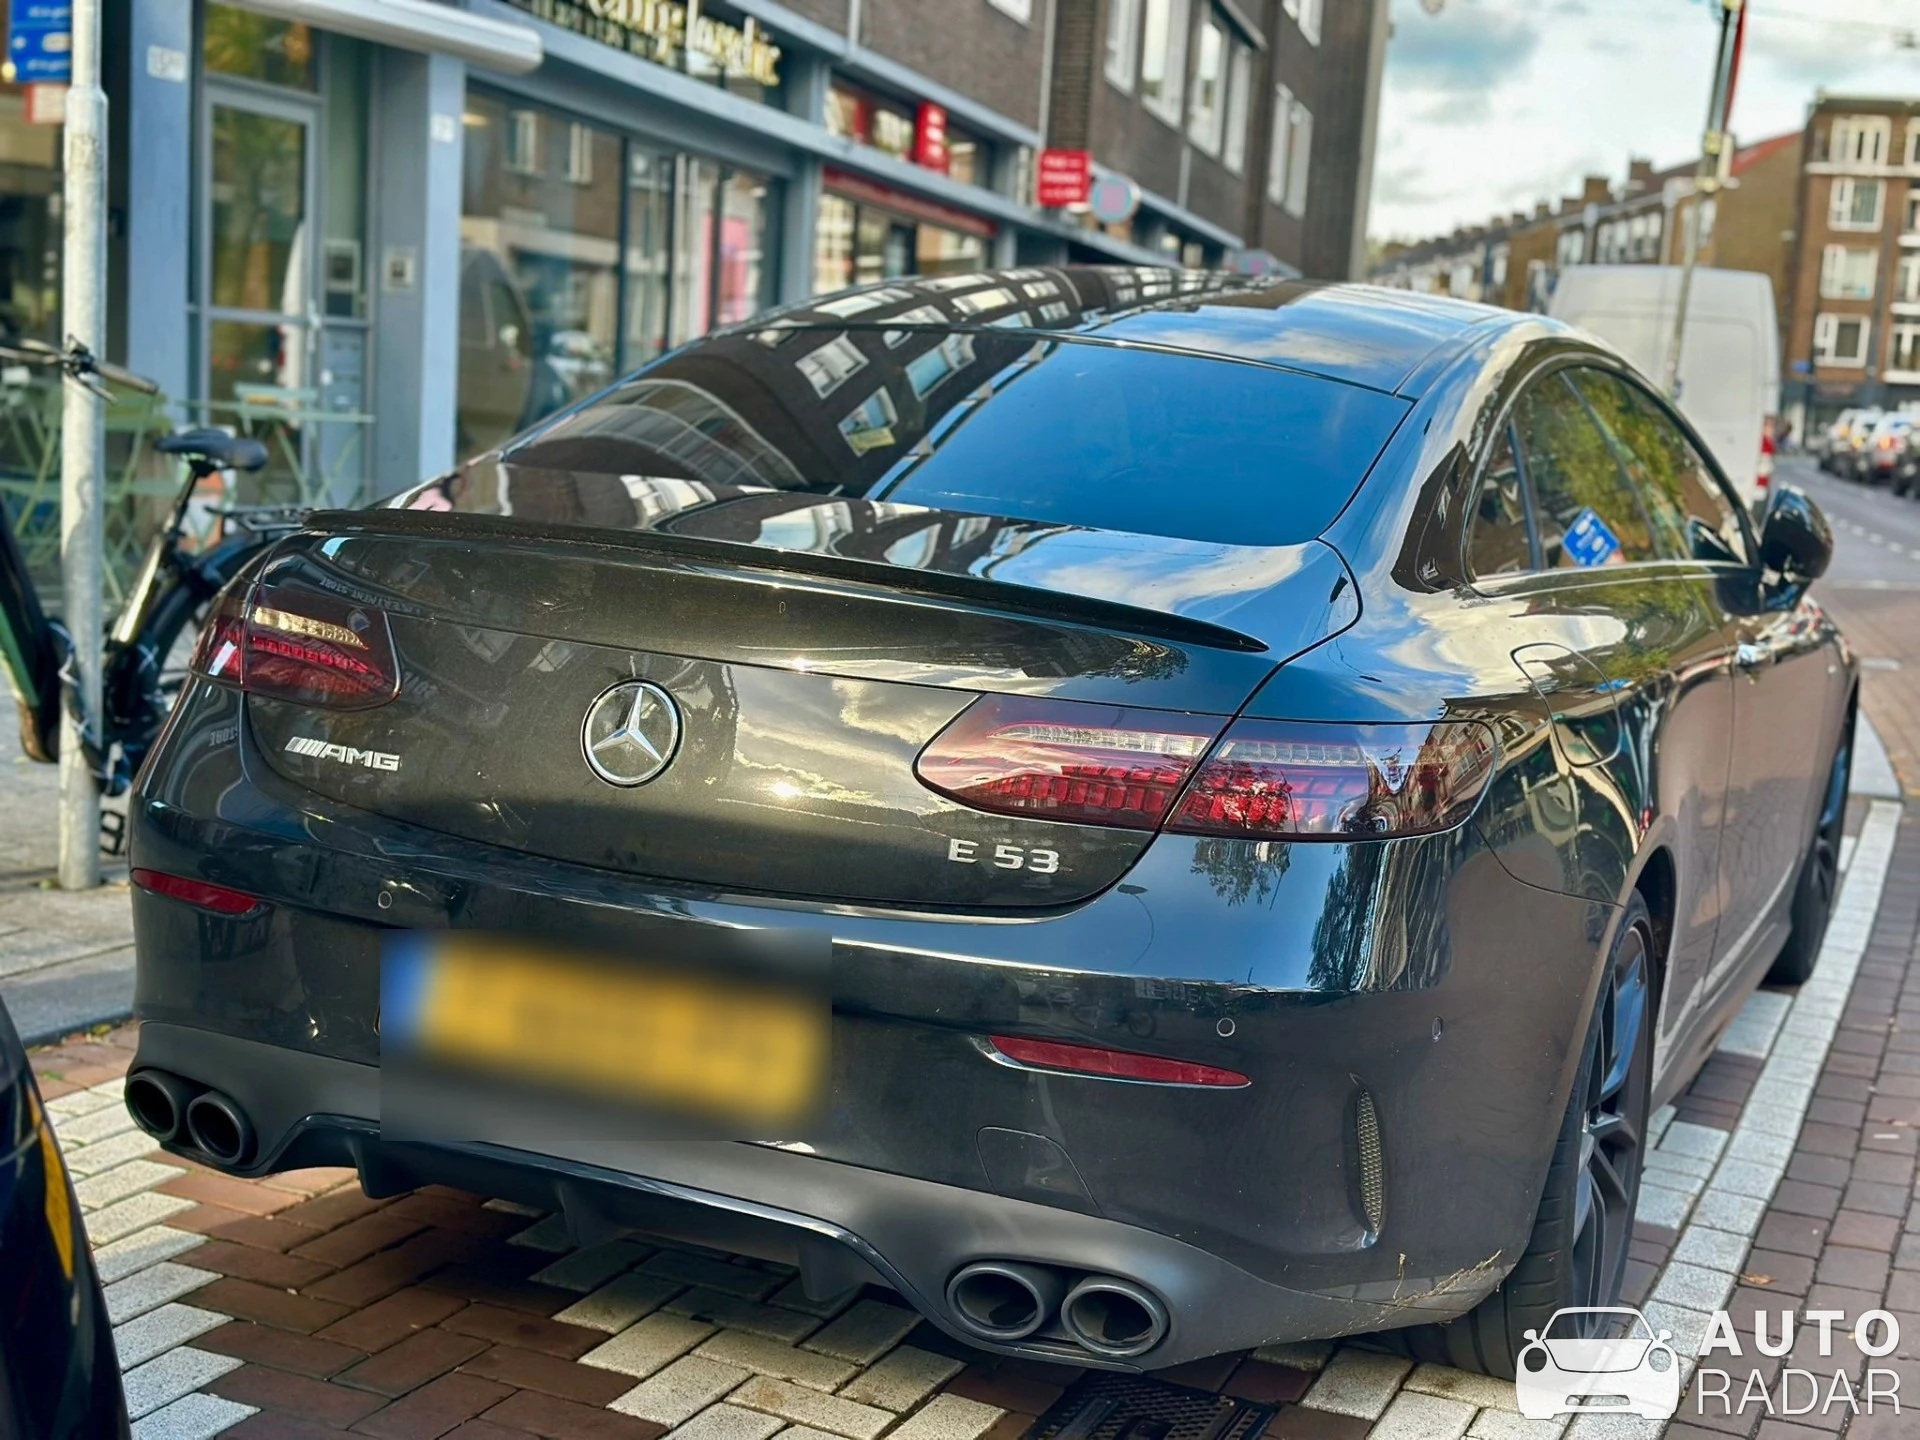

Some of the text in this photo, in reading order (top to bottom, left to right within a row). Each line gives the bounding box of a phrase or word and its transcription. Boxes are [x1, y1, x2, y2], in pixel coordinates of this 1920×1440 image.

[318, 743, 400, 772] AMG
[948, 838, 1060, 874] E 53
